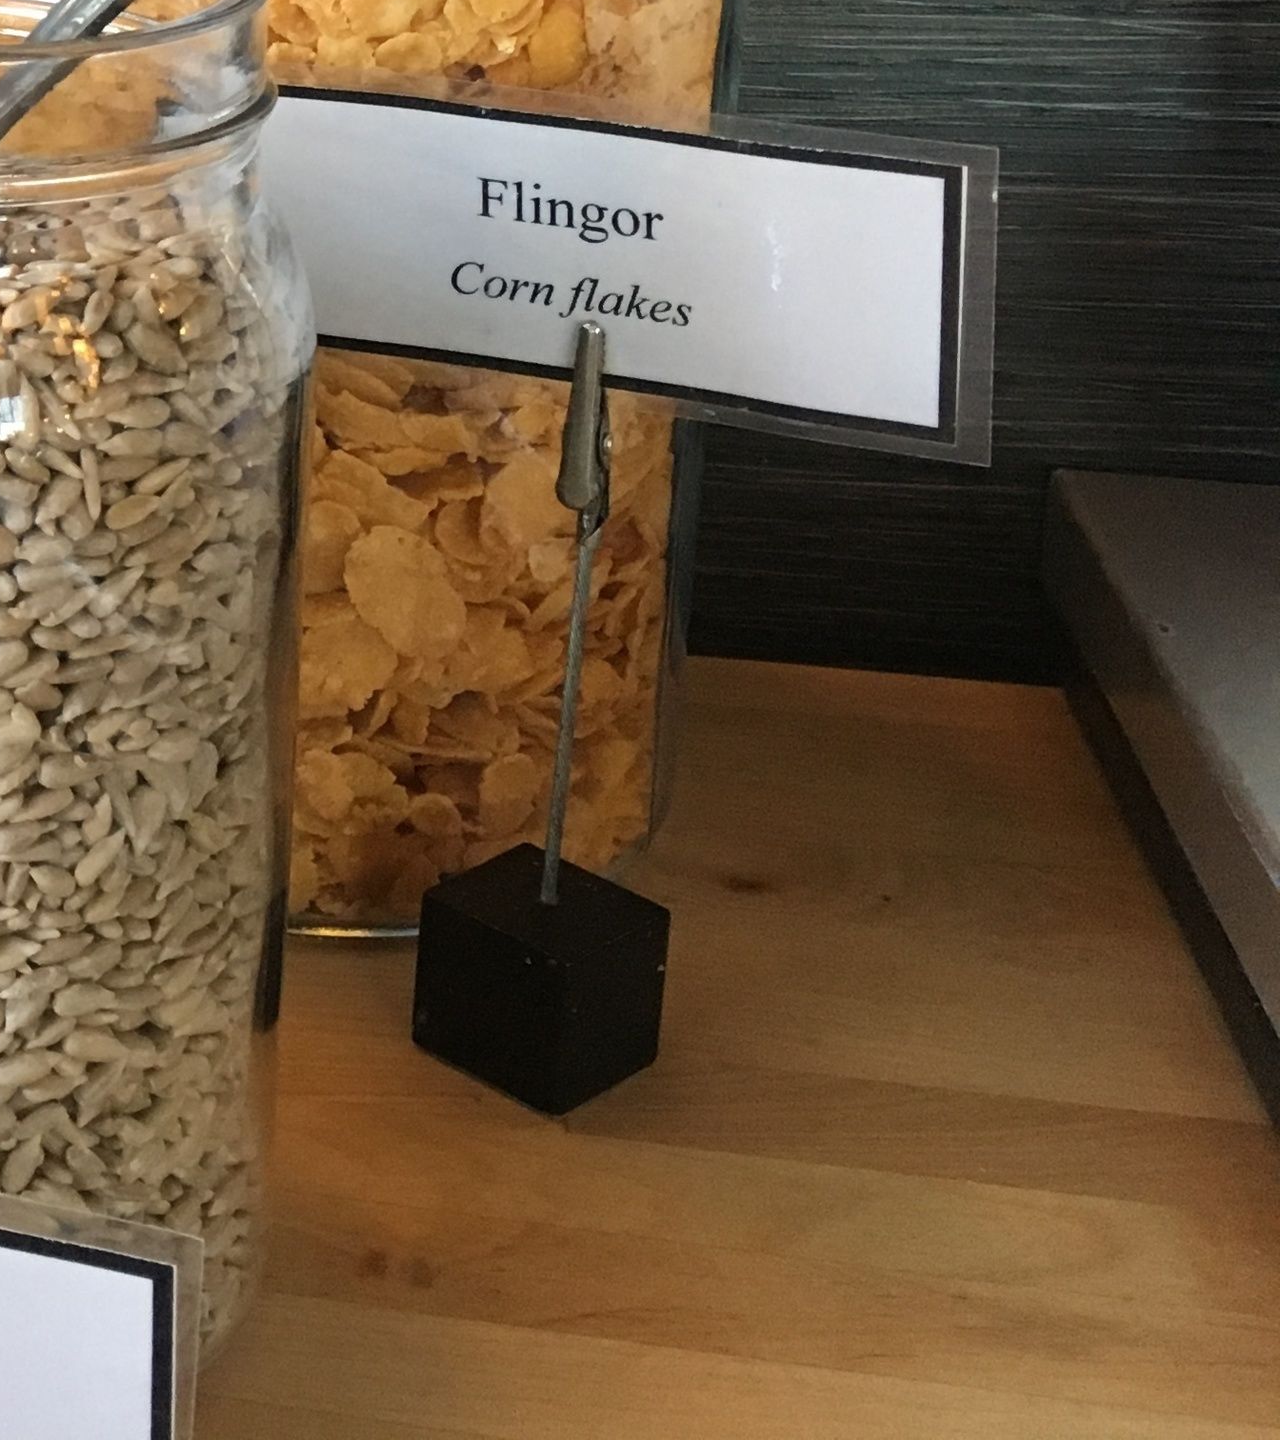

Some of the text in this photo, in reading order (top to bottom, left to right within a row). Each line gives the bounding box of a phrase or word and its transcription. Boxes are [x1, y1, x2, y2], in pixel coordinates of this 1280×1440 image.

[476, 176, 665, 244] Flingor
[450, 261, 693, 328] Corn flakes
